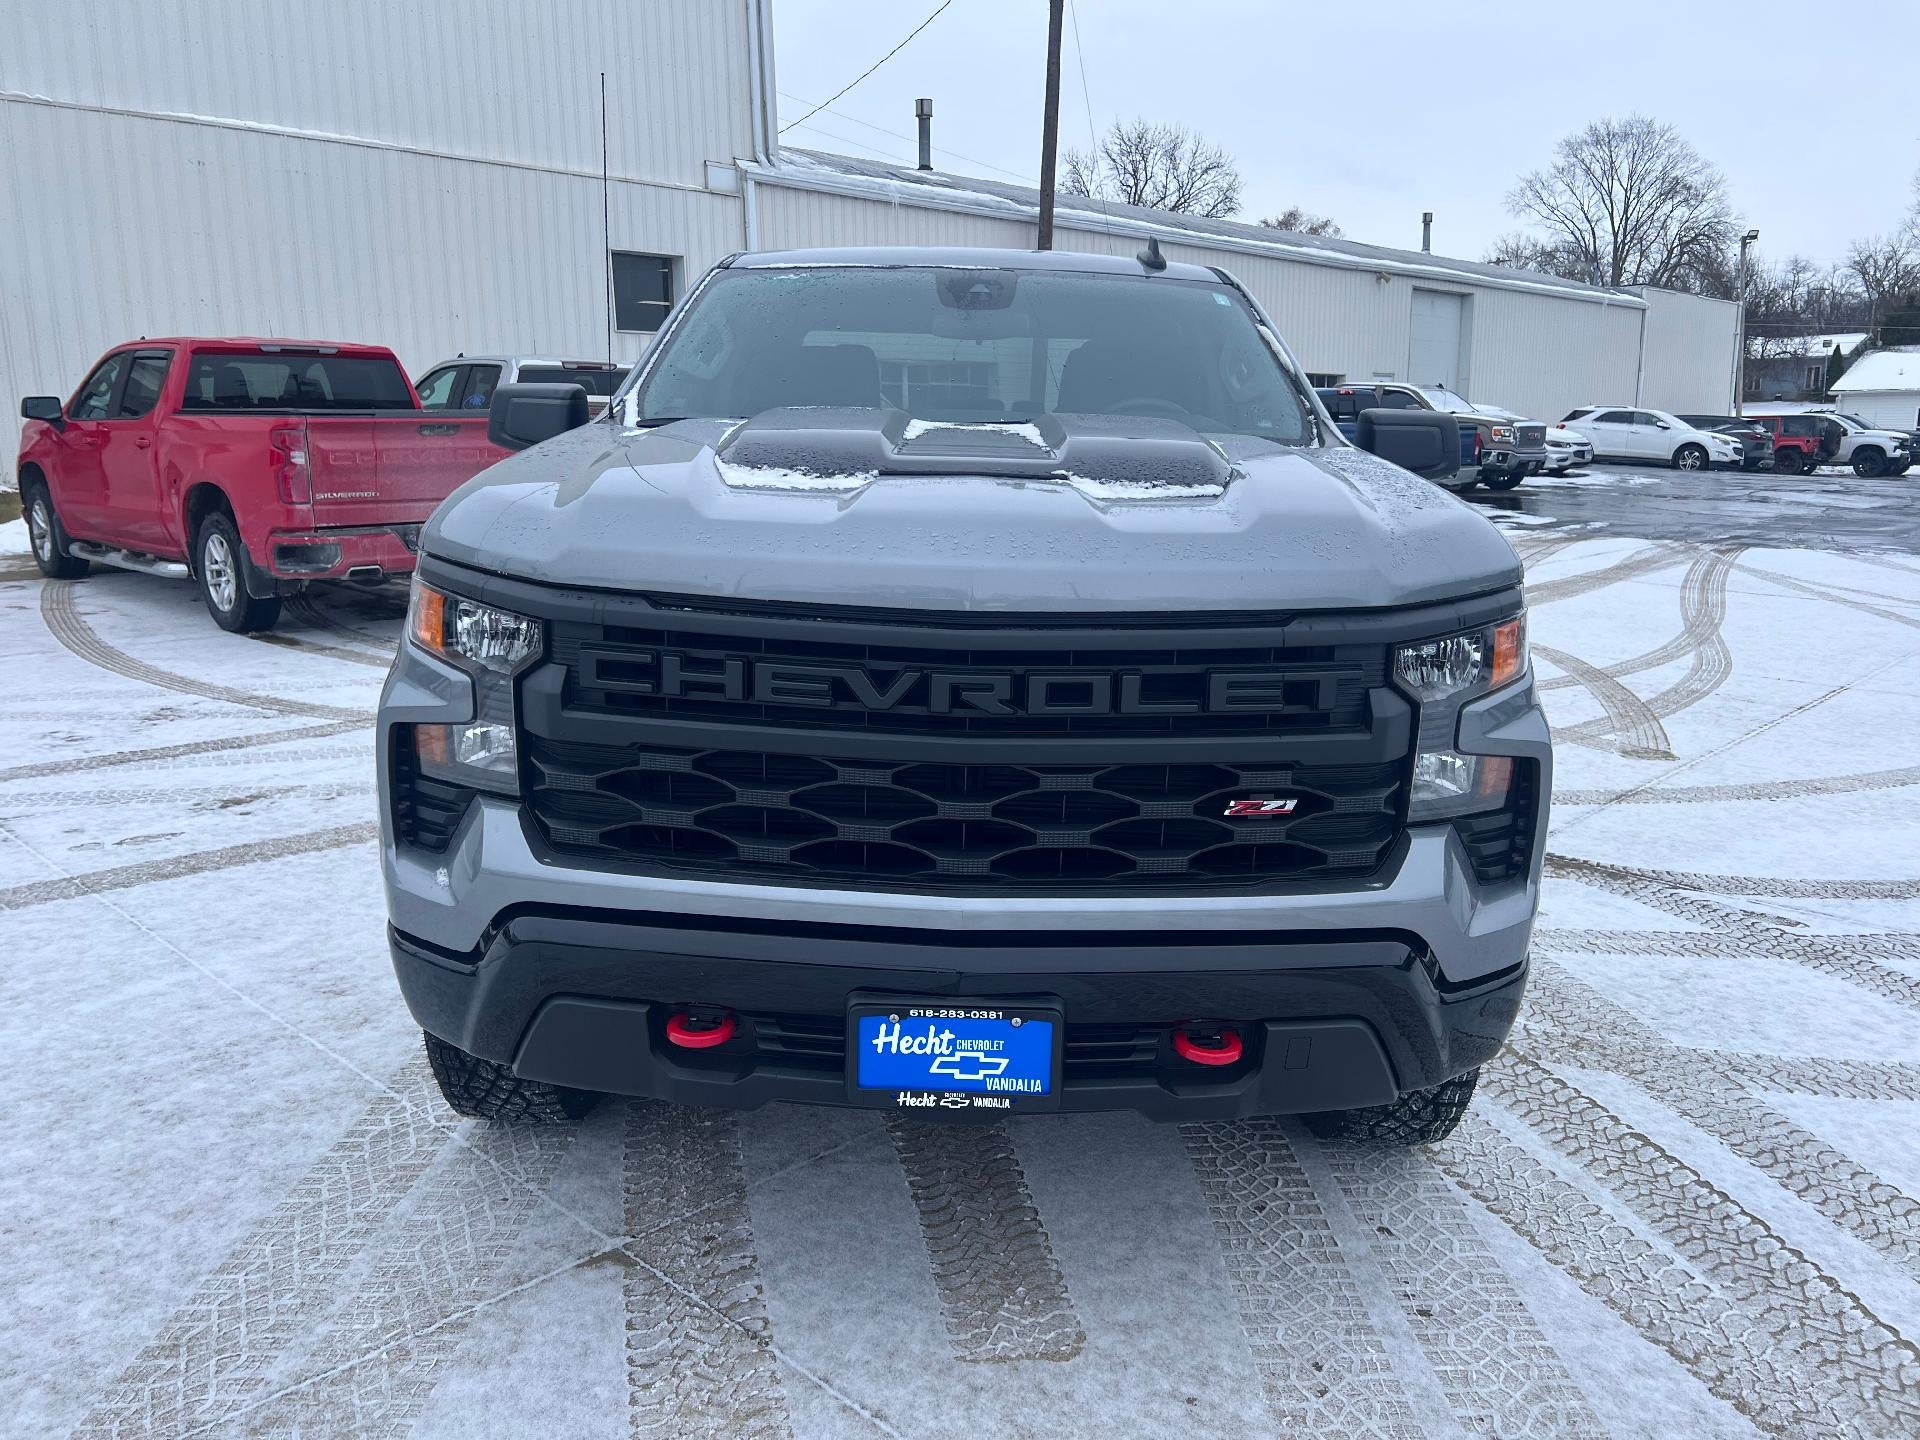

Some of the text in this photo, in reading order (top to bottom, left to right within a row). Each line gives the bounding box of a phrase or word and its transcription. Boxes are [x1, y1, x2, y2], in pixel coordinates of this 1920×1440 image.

[315, 491, 380, 500] SILVERADO
[579, 645, 1364, 715] CHEVROLET
[1223, 799, 1298, 816] Z71
[909, 1009, 1003, 1020] 618-283-0381
[872, 1023, 1005, 1055] Hecht CHEVROLET
[986, 1077, 1042, 1093] VANDALIA
[897, 1091, 937, 1107] Hecht
[973, 1096, 1010, 1108] VANDALIA
